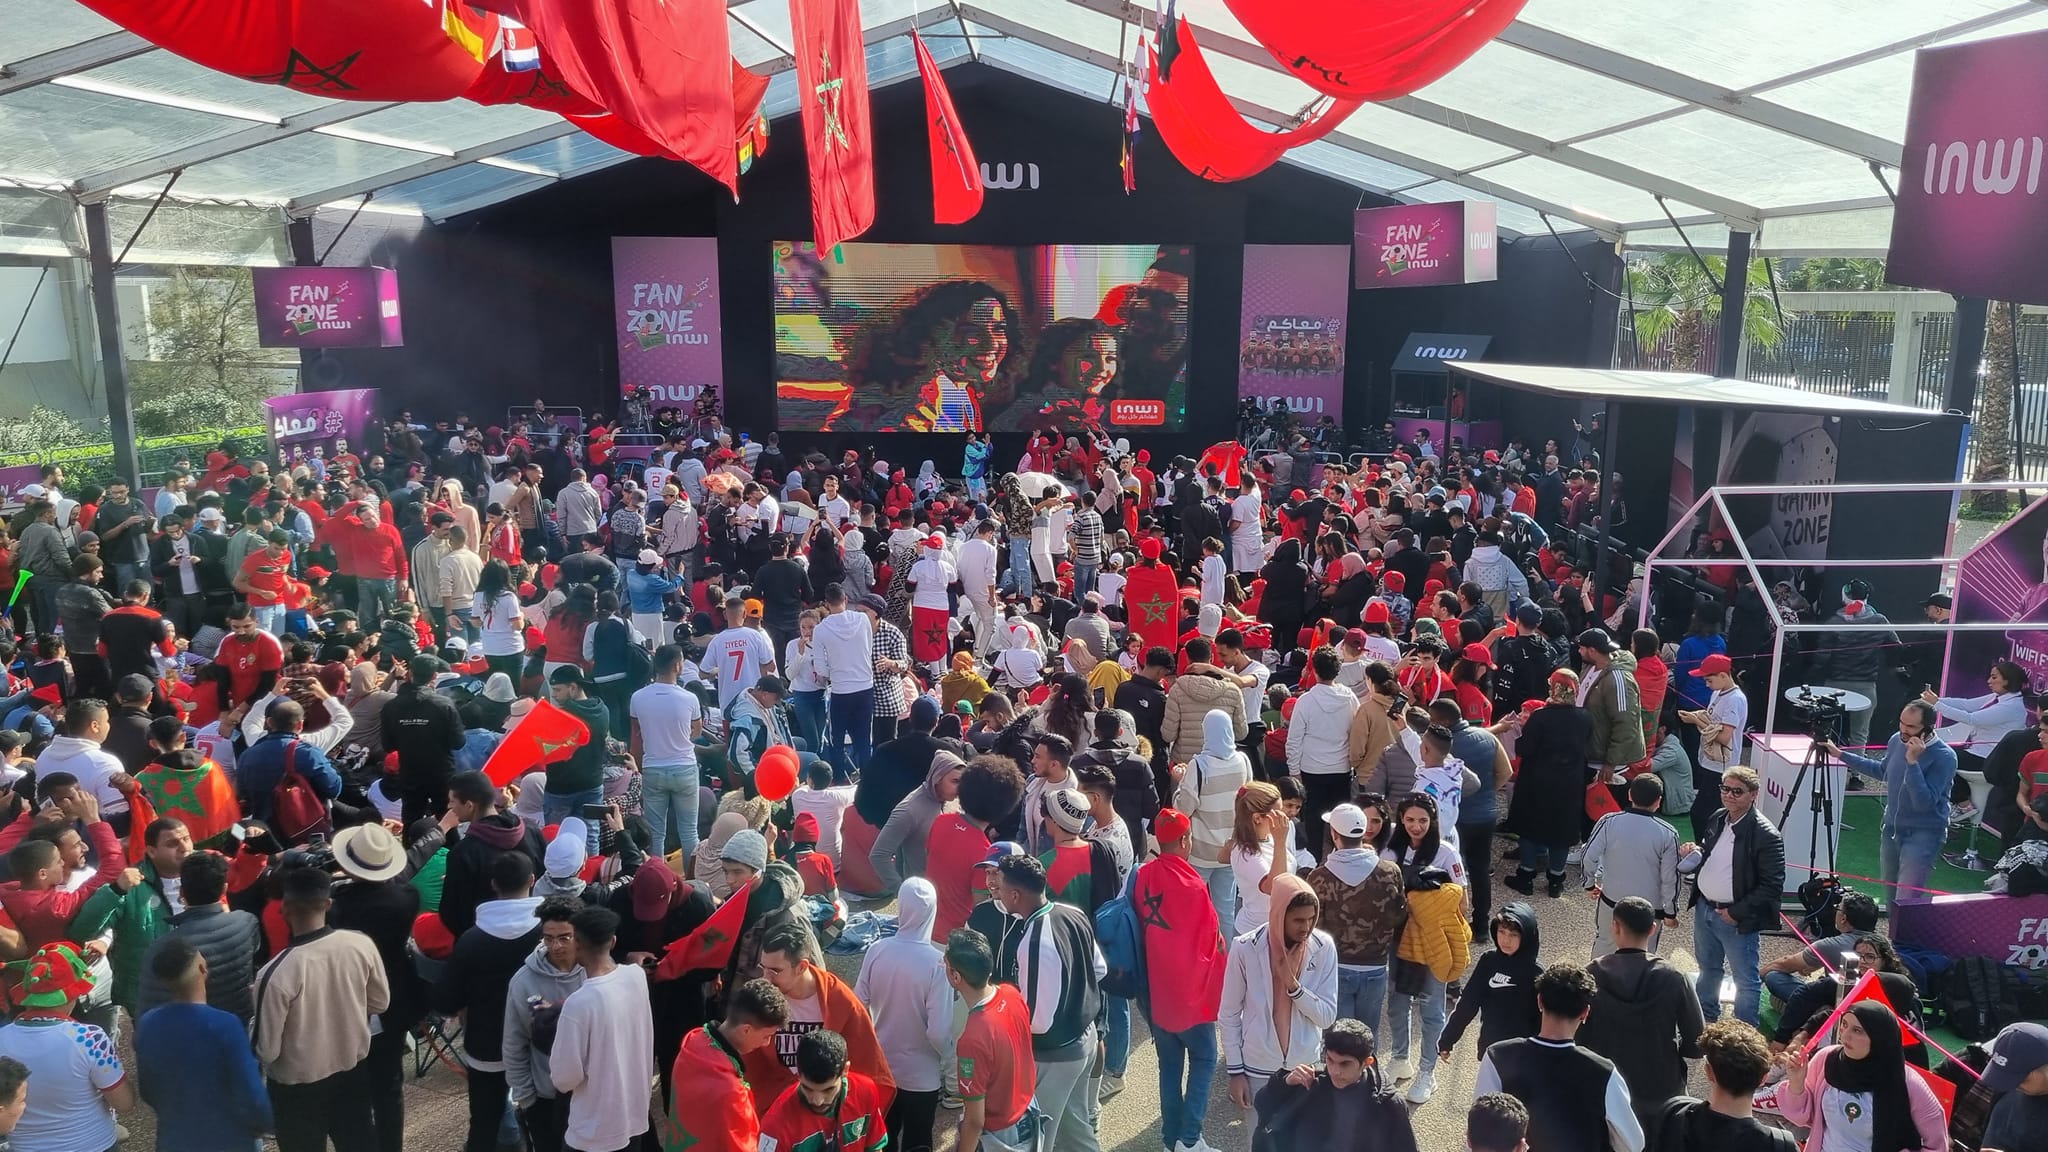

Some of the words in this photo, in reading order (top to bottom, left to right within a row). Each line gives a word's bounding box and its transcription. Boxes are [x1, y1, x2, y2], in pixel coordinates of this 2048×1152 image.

[1387, 224, 1422, 244] FAN
[1381, 242, 1428, 264] ZONE
[289, 285, 329, 303] FAN
[633, 284, 684, 308] FAN
[285, 303, 339, 322] ZONE
[627, 310, 703, 335] ZONE
[652, 476, 661, 488] 2
[1783, 514, 1828, 548] ZONE
[724, 639, 748, 649] ZIYECH
[728, 650, 745, 682] 7
